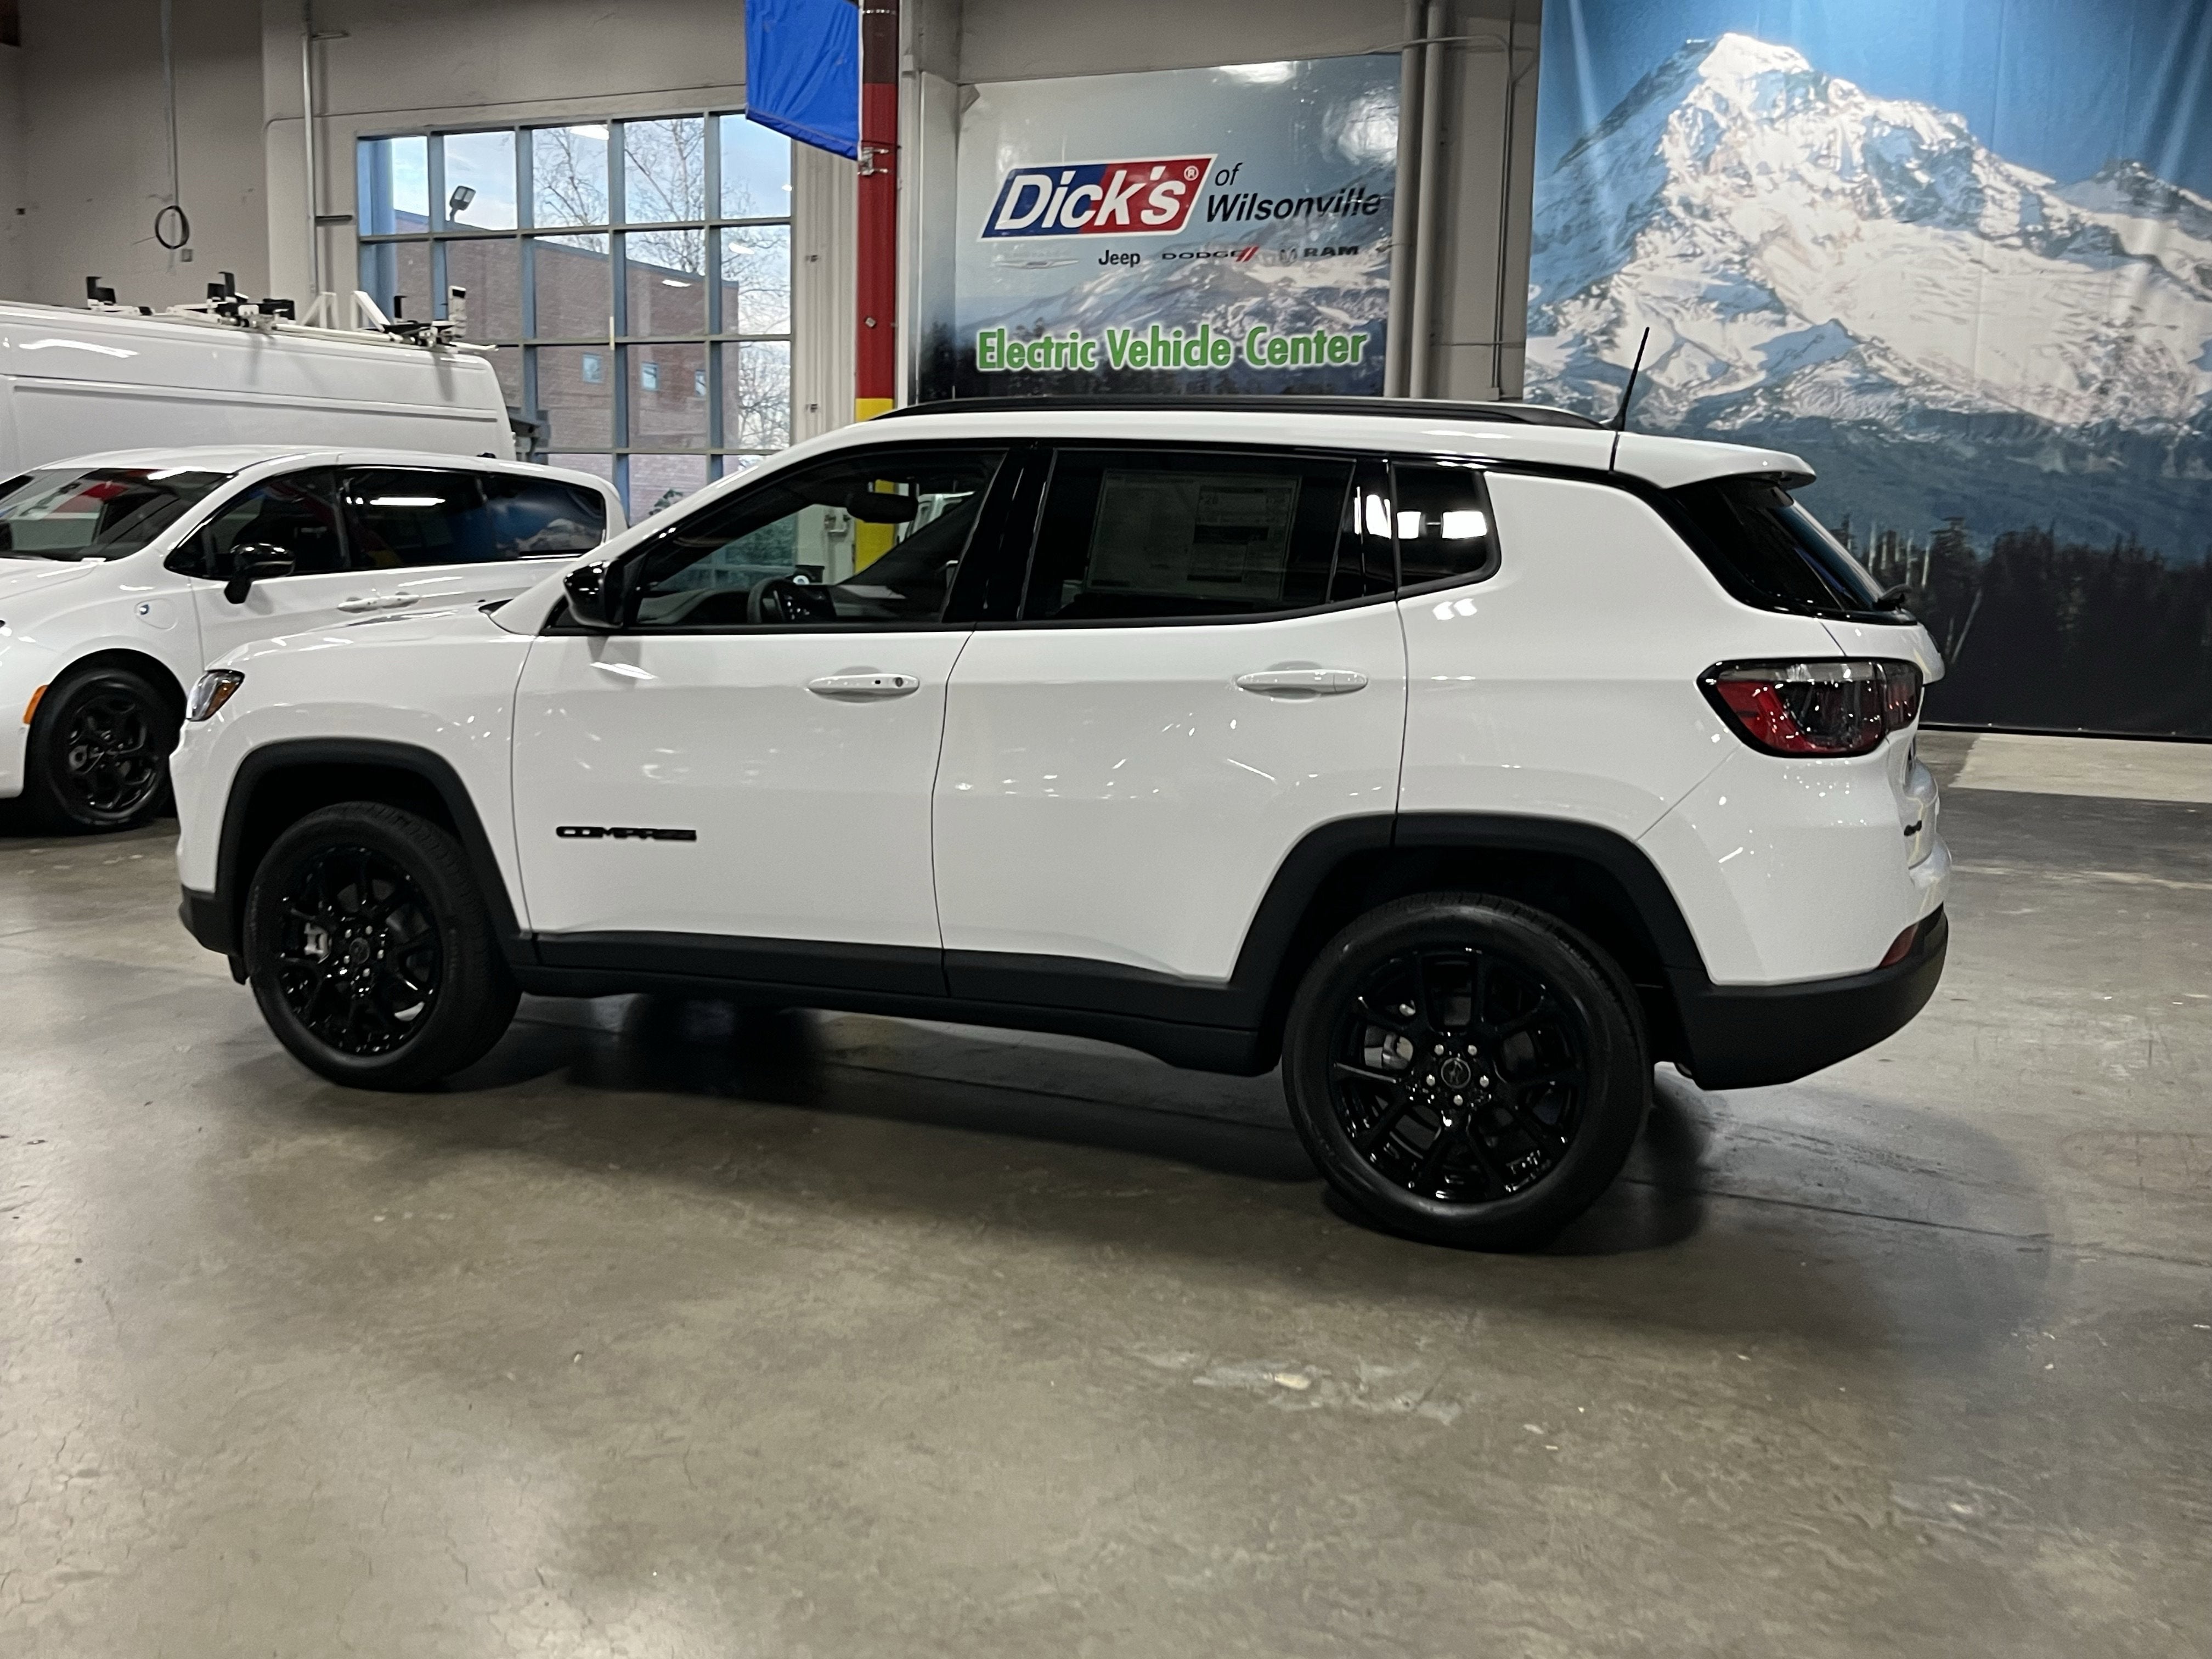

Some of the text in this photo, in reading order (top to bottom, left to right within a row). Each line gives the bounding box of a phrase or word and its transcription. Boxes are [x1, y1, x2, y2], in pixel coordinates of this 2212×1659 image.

[1214, 162, 1243, 187] of
[1206, 185, 1382, 223] Wilsonville
[1098, 249, 1141, 268] Jeep
[1303, 245, 1360, 257] RAM
[978, 324, 1368, 369] Electric Vehicle Center
[556, 826, 697, 842] COMPASS
